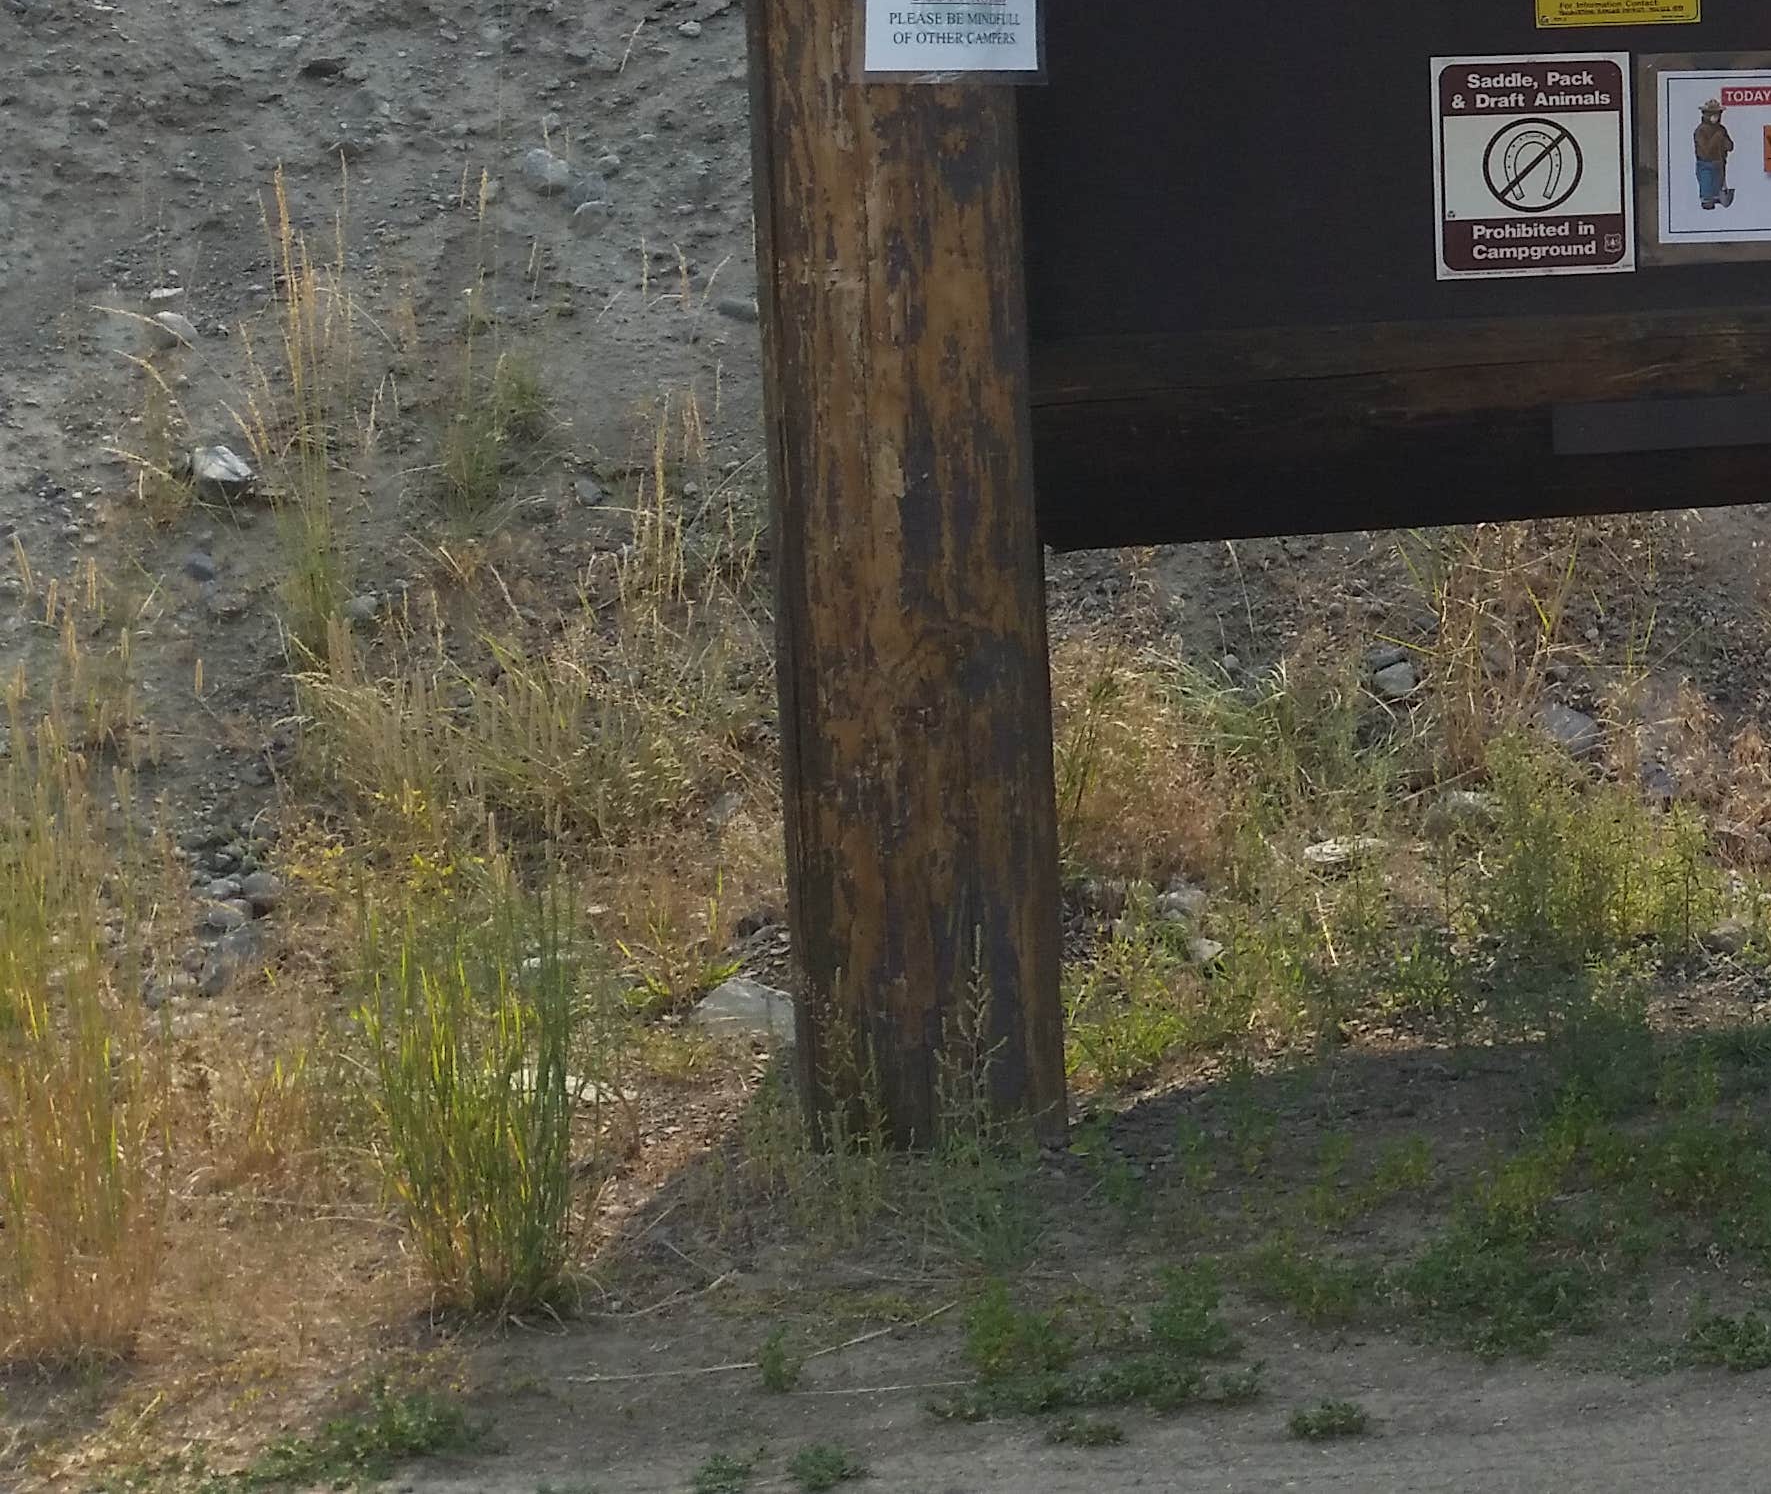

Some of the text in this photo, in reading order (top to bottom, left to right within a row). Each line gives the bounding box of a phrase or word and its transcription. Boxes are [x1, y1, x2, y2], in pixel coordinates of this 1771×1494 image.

[889, 12, 1021, 26] PLEASE BE MINDFULL
[893, 32, 1016, 45] OF OTHER CAMPERS
[1467, 70, 1594, 89] Saddle, Pack
[1451, 90, 1611, 109] & Draft Animals
[1472, 221, 1595, 240] Prohibited in
[1472, 240, 1597, 261] Campground
